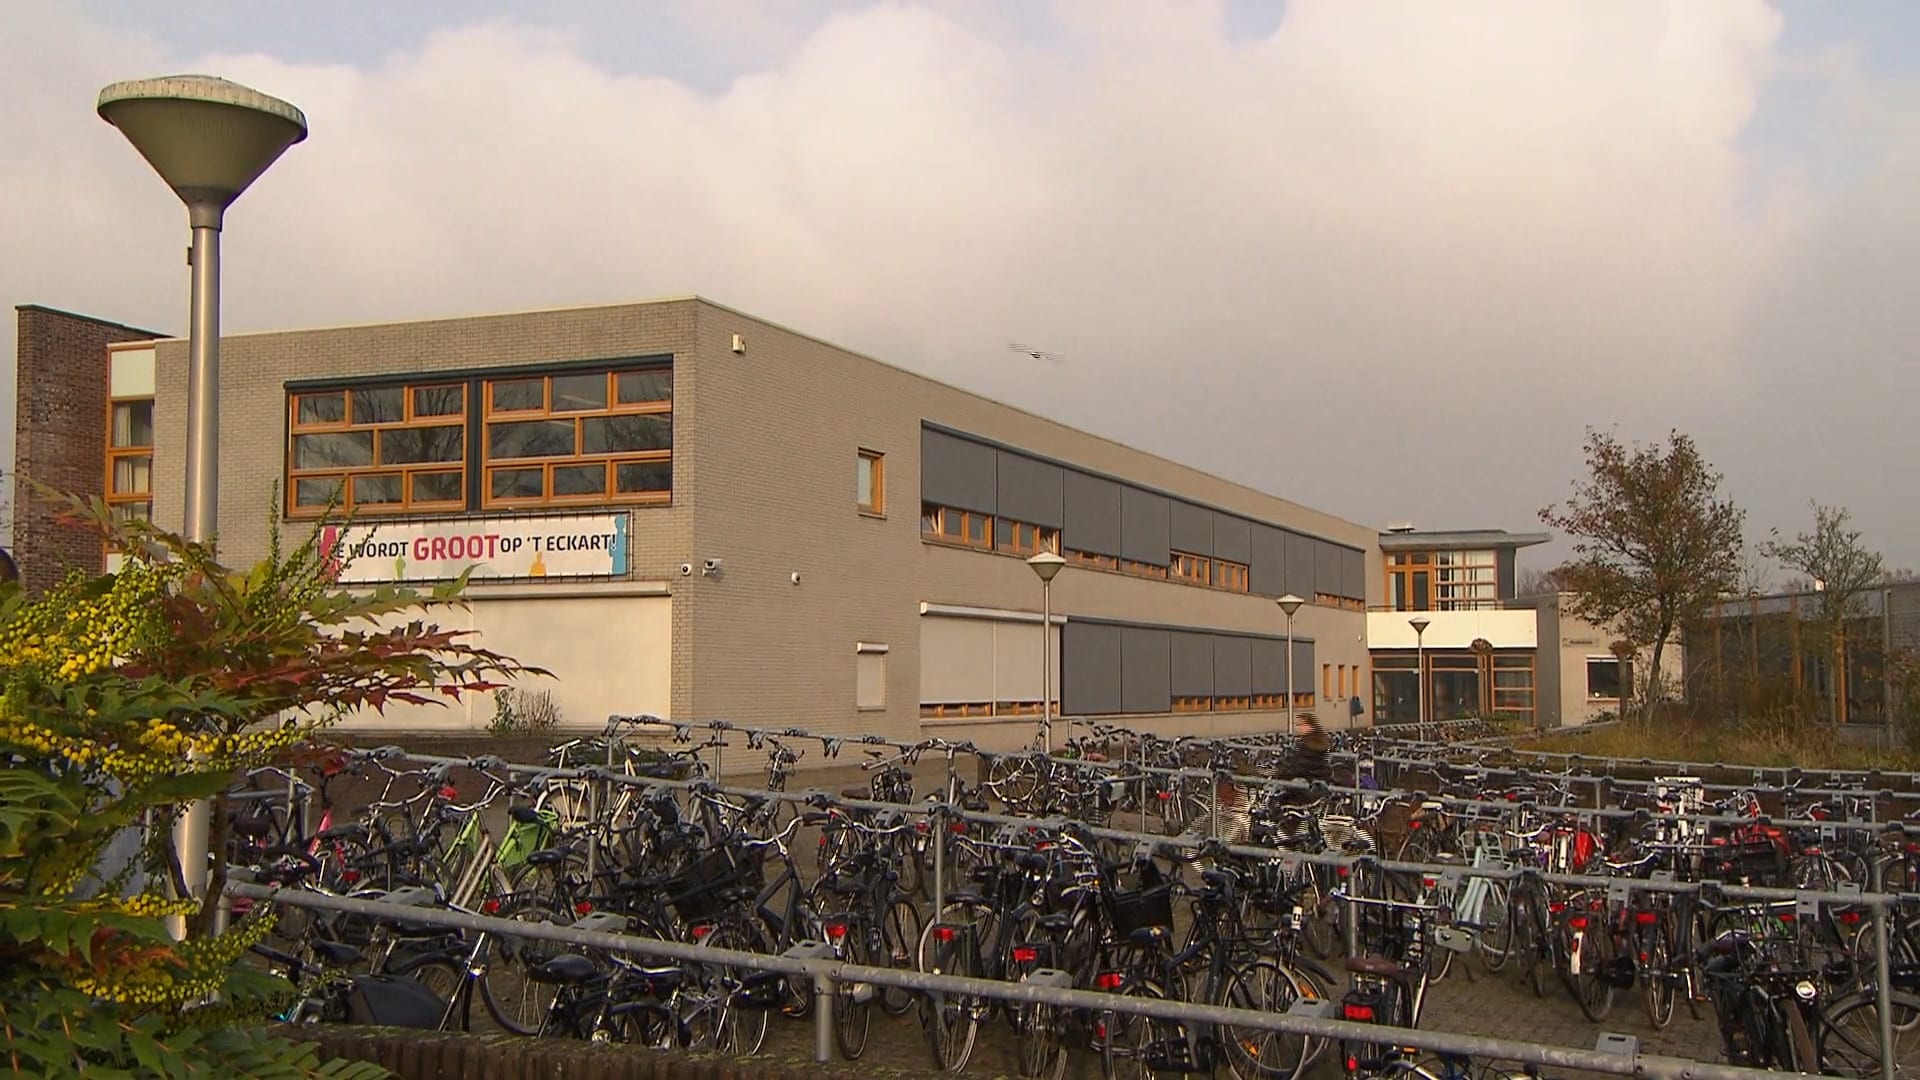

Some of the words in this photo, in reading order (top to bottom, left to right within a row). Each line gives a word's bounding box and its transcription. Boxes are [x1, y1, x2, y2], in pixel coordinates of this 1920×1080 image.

[349, 542, 409, 558] WORDT
[413, 534, 499, 561] GROOT
[500, 537, 517, 553] OP
[546, 533, 616, 551] ECKART!
